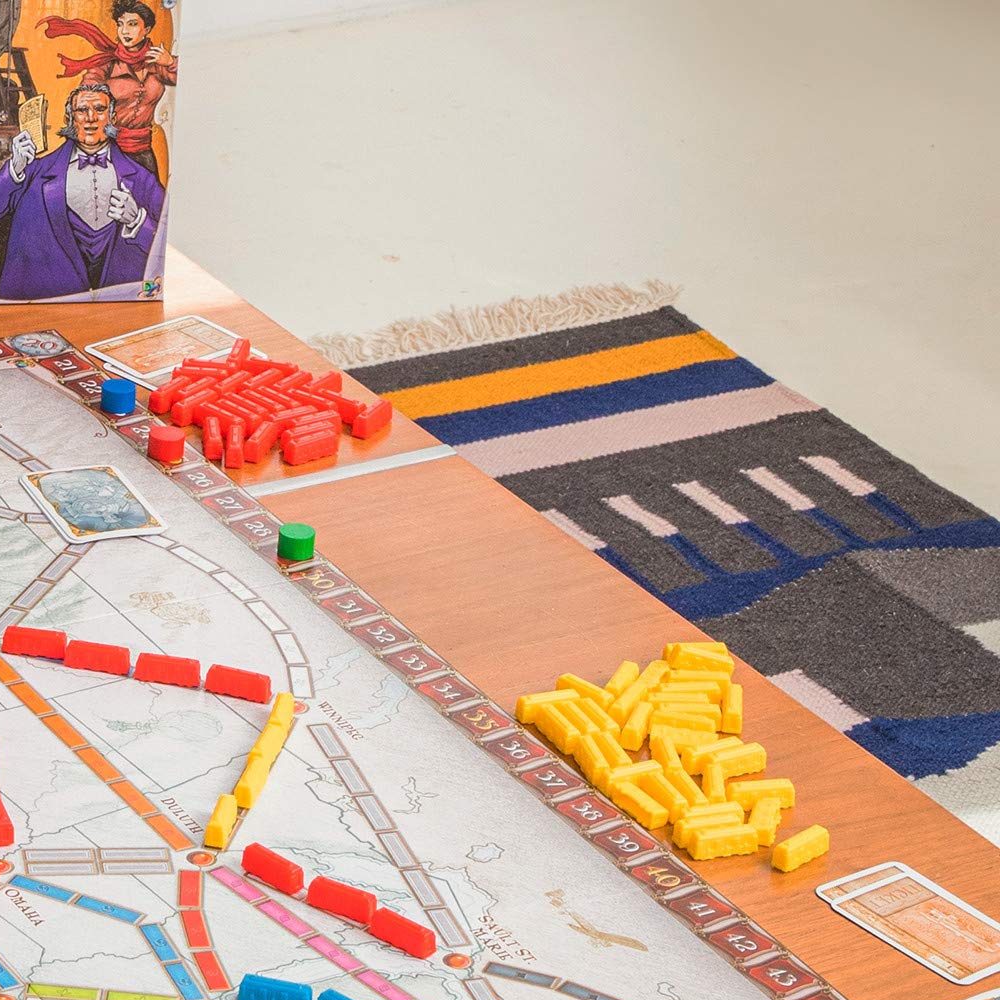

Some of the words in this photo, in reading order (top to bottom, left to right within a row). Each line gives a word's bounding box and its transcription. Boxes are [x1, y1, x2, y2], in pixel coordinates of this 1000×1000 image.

[22, 338, 57, 350] 20
[54, 359, 78, 371] 21
[78, 380, 102, 394] 22
[187, 472, 214, 488] 26
[216, 496, 243, 510] 27
[244, 521, 272, 537] 28
[304, 570, 335, 588] 30
[336, 600, 362, 614] 31
[367, 626, 396, 642] 32
[400, 654, 428, 670] 33
[432, 682, 460, 700] 34
[318, 701, 364, 742] WINNIPEG
[463, 710, 500, 730] 35
[501, 740, 530, 758] 36
[536, 770, 568, 787] 37
[161, 797, 204, 835] DULUTH
[571, 802, 602, 820] 38
[608, 832, 640, 852] 39
[647, 866, 681, 887] 40
[4, 888, 46, 927] OMAHA
[688, 902, 716, 917] 41
[478, 915, 520, 948] SAULT
[473, 928, 513, 960] MARIE
[726, 932, 758, 952] 42
[767, 967, 796, 987] 43
